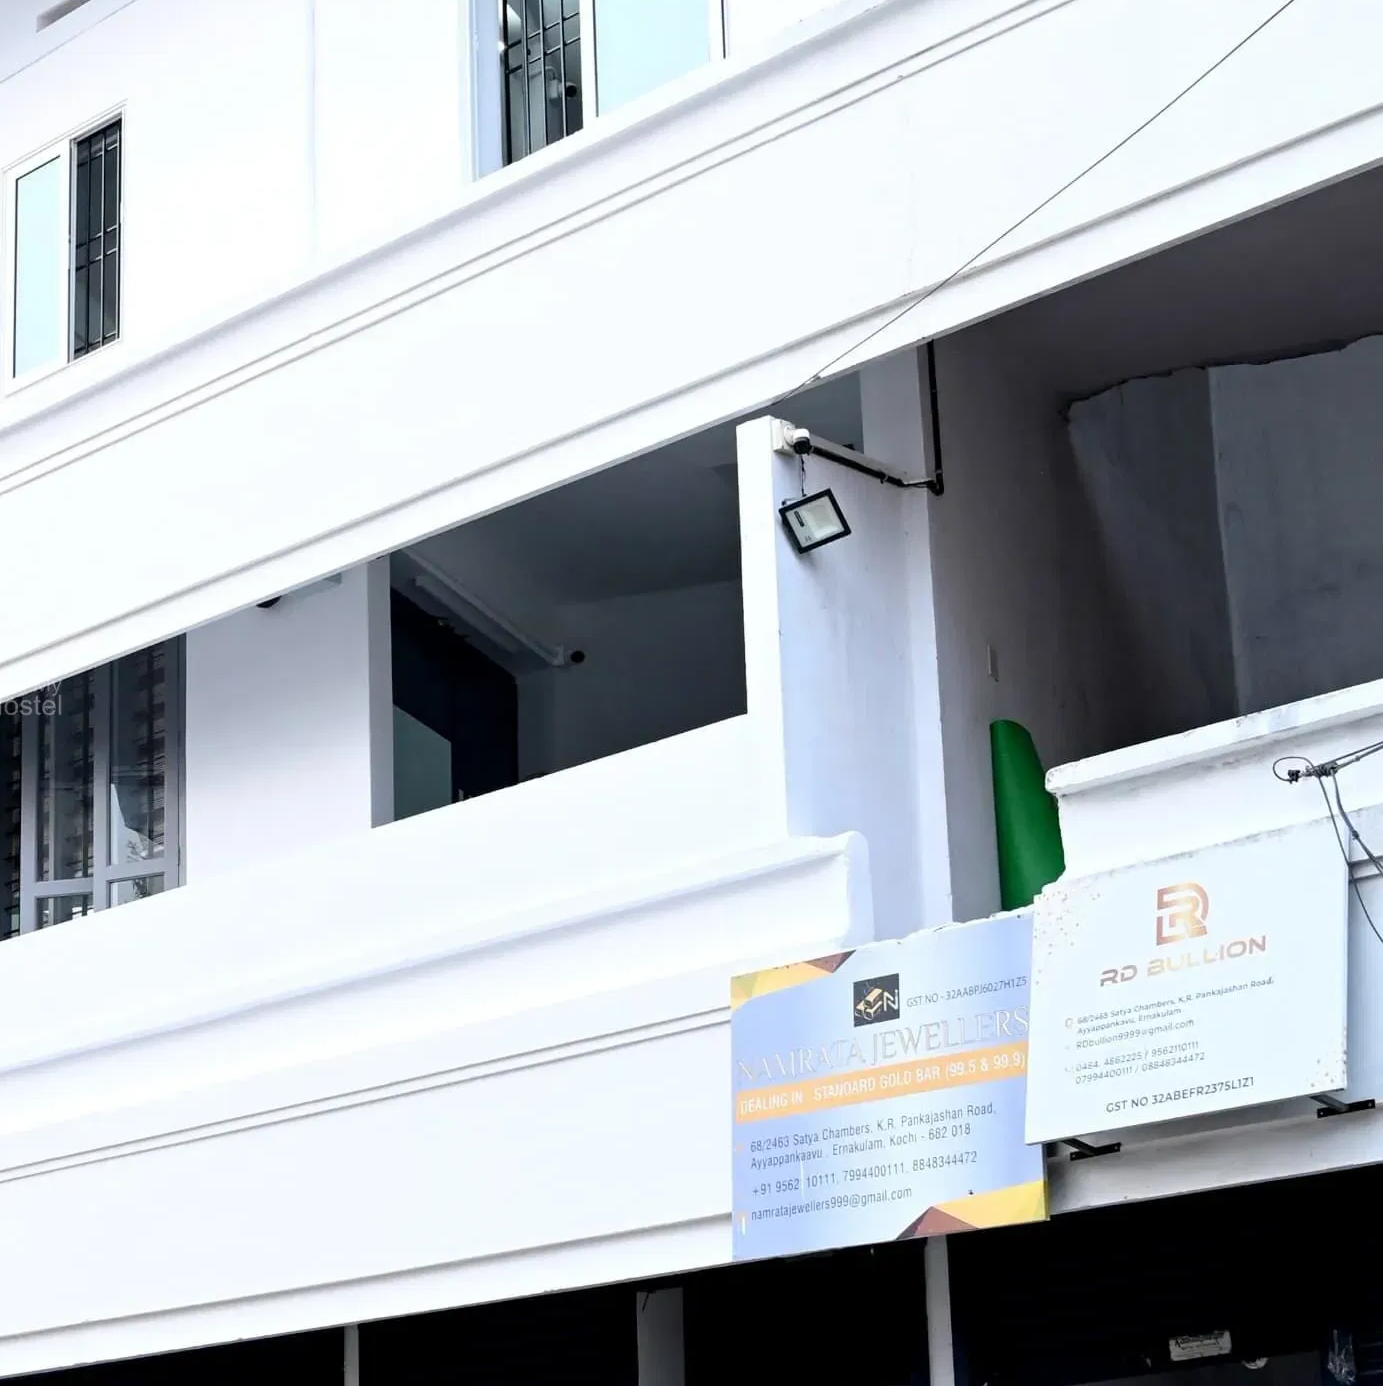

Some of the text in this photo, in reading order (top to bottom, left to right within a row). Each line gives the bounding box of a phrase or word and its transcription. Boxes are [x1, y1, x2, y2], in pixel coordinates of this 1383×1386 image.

[1099, 934, 1267, 987] RD BULLION
[906, 995, 923, 1008] GST
[925, 993, 939, 1005] NO
[871, 1005, 1029, 1066] JEWELLERS
[740, 1093, 788, 1116] DEALING
[792, 1090, 803, 1104] IN
[813, 1077, 876, 1102] STANDARD
[880, 1071, 912, 1089] GOLD
[916, 1066, 941, 1083] BAR
[1105, 1100, 1128, 1113] GST
[1131, 1096, 1149, 1108] NO
[750, 1135, 789, 1153] 68/2463
[793, 1133, 819, 1147] Satya
[901, 1108, 963, 1128] Pankajashan
[889, 1132, 917, 1147] Kochi
[928, 1126, 948, 1141] 682
[951, 1122, 971, 1138] 018
[752, 1183, 772, 1197] +91
[912, 1150, 977, 1172] 8848344472
[751, 1186, 912, 1222] namratajewellers999@gmail.com
